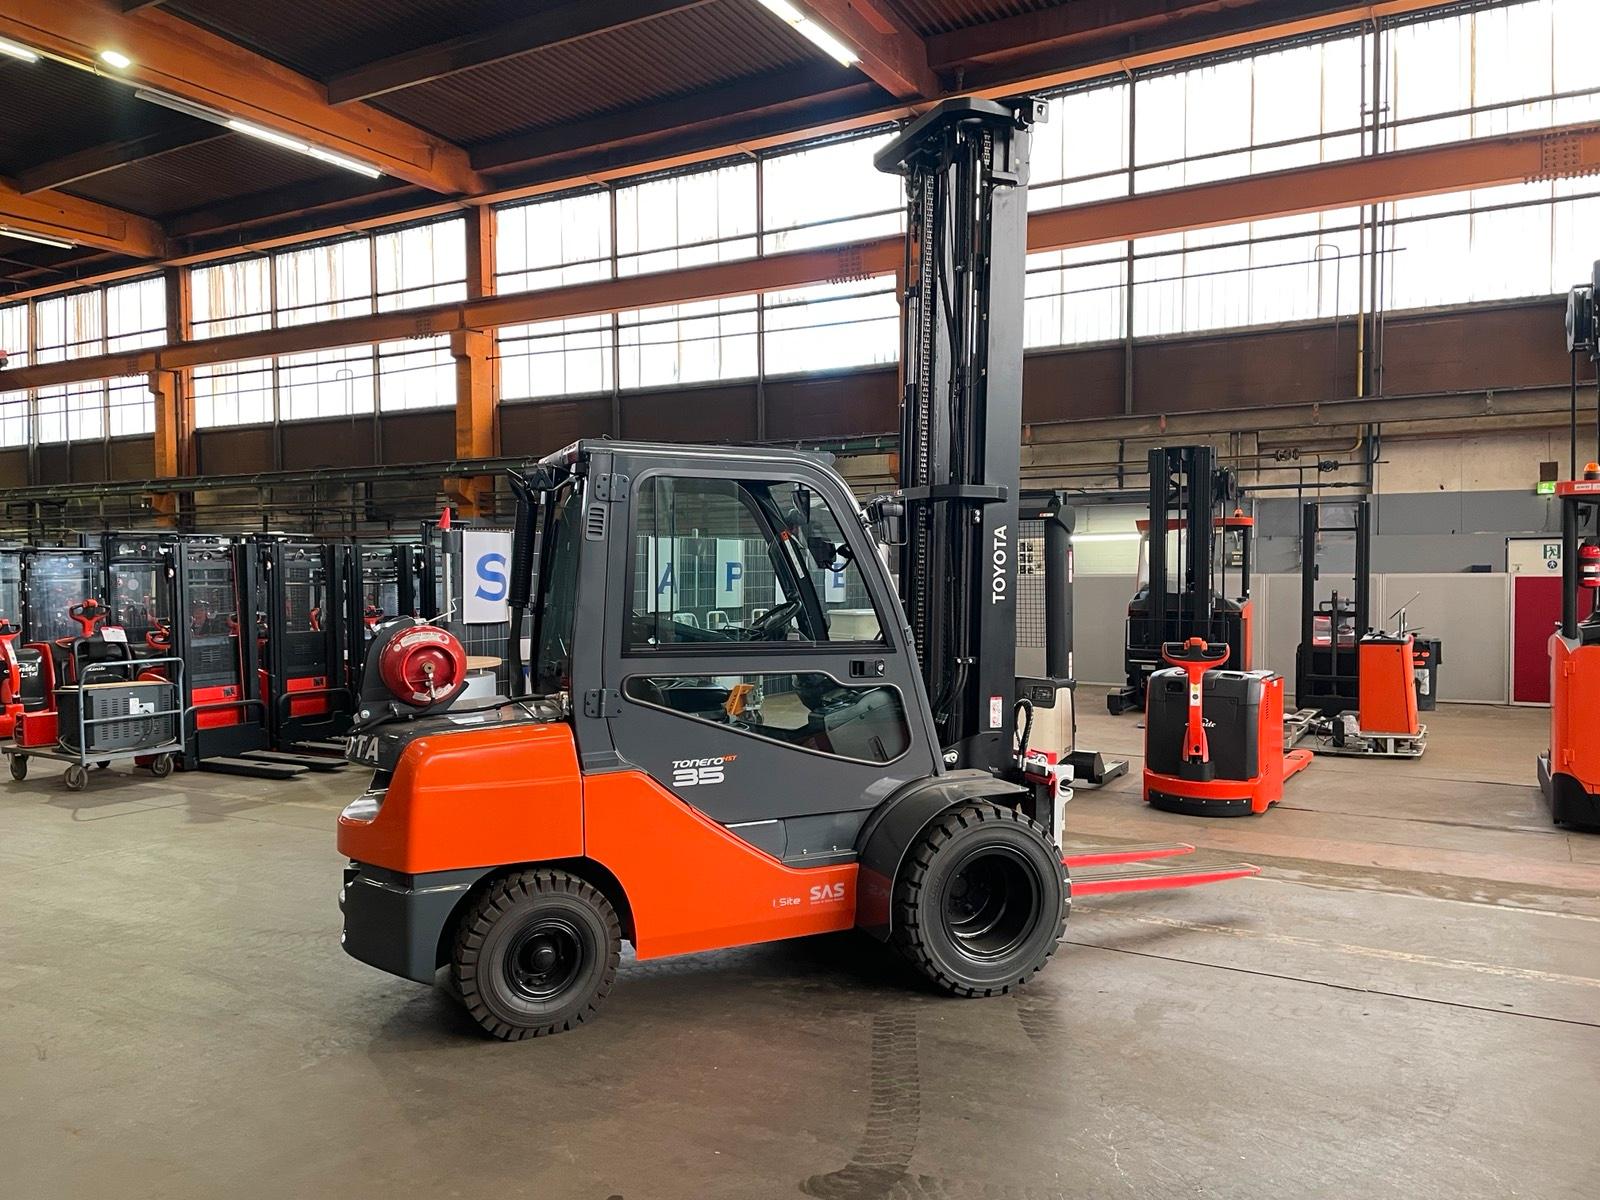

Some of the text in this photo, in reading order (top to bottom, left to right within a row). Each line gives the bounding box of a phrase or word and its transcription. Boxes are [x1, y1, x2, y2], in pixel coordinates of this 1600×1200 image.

[475, 553, 507, 602] S
[658, 562, 677, 594] A
[726, 562, 743, 592] P
[992, 525, 1007, 604] TOYOTA
[672, 766, 725, 787] 35
[809, 882, 845, 901] SAS
